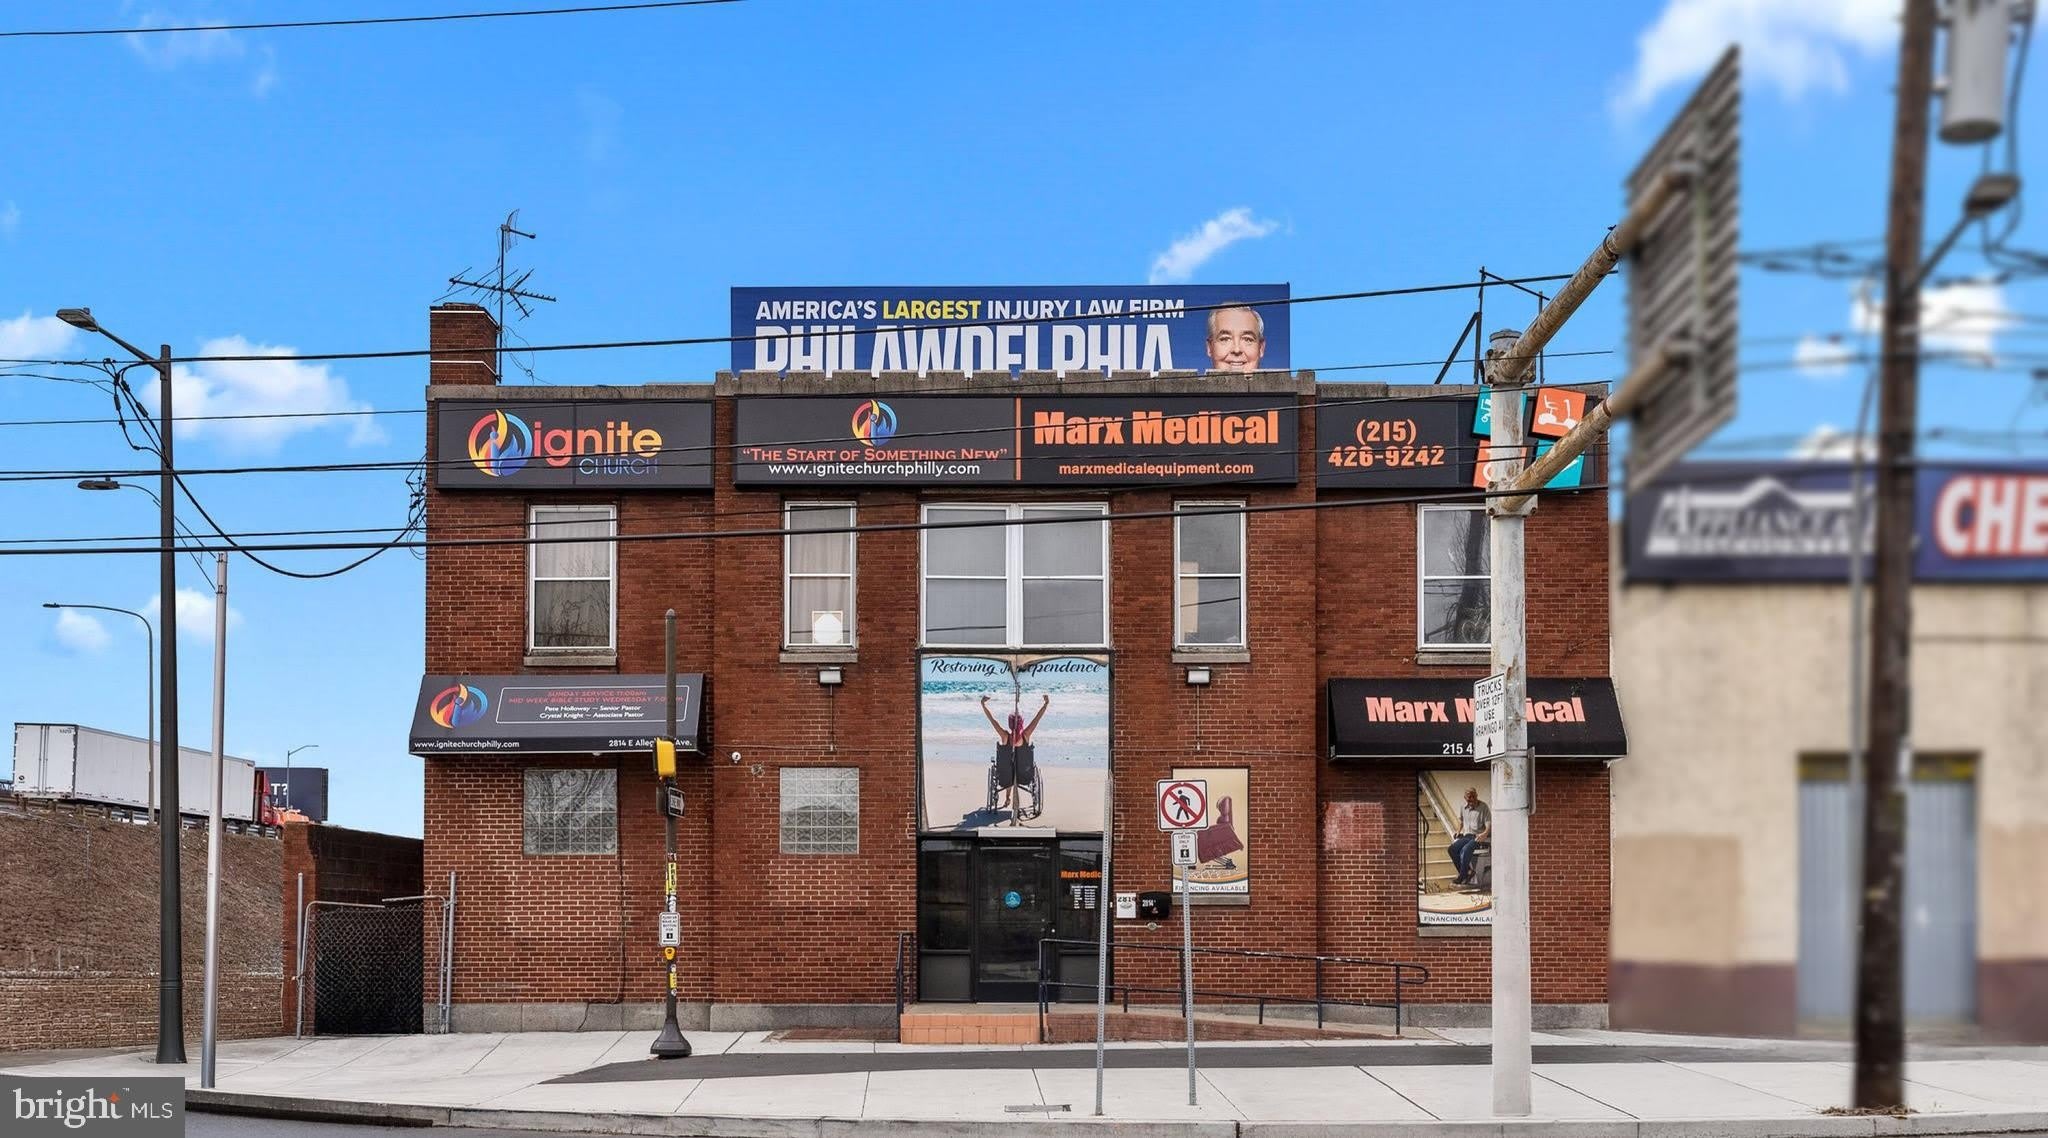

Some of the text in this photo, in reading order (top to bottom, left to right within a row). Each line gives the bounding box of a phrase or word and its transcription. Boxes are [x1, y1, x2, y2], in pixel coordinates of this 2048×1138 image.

[882, 300, 982, 320] LARGEST
[987, 300, 1070, 320] INJURY
[1076, 299, 1124, 318] LAW
[1129, 299, 1185, 318] FIRM
[1034, 411, 1279, 445] Marx Medical
[1356, 419, 1417, 445] (215)
[533, 421, 662, 467] ignite
[1328, 445, 1445, 467] 426-9242
[579, 458, 658, 475] CHURCH
[768, 461, 980, 477] www.ignitechurchphilly.com
[1059, 462, 1254, 477] marxmedicalequipment.com
[931, 659, 998, 677] Restoring
[1477, 678, 1502, 697] TRUCKS
[1365, 697, 1586, 723] Marx Mical
[1476, 697, 1490, 711] OVER
[1484, 708, 1495, 721] USE
[414, 740, 520, 749] www.ignitechurchphilly.com
[1442, 743, 1464, 754] 215
